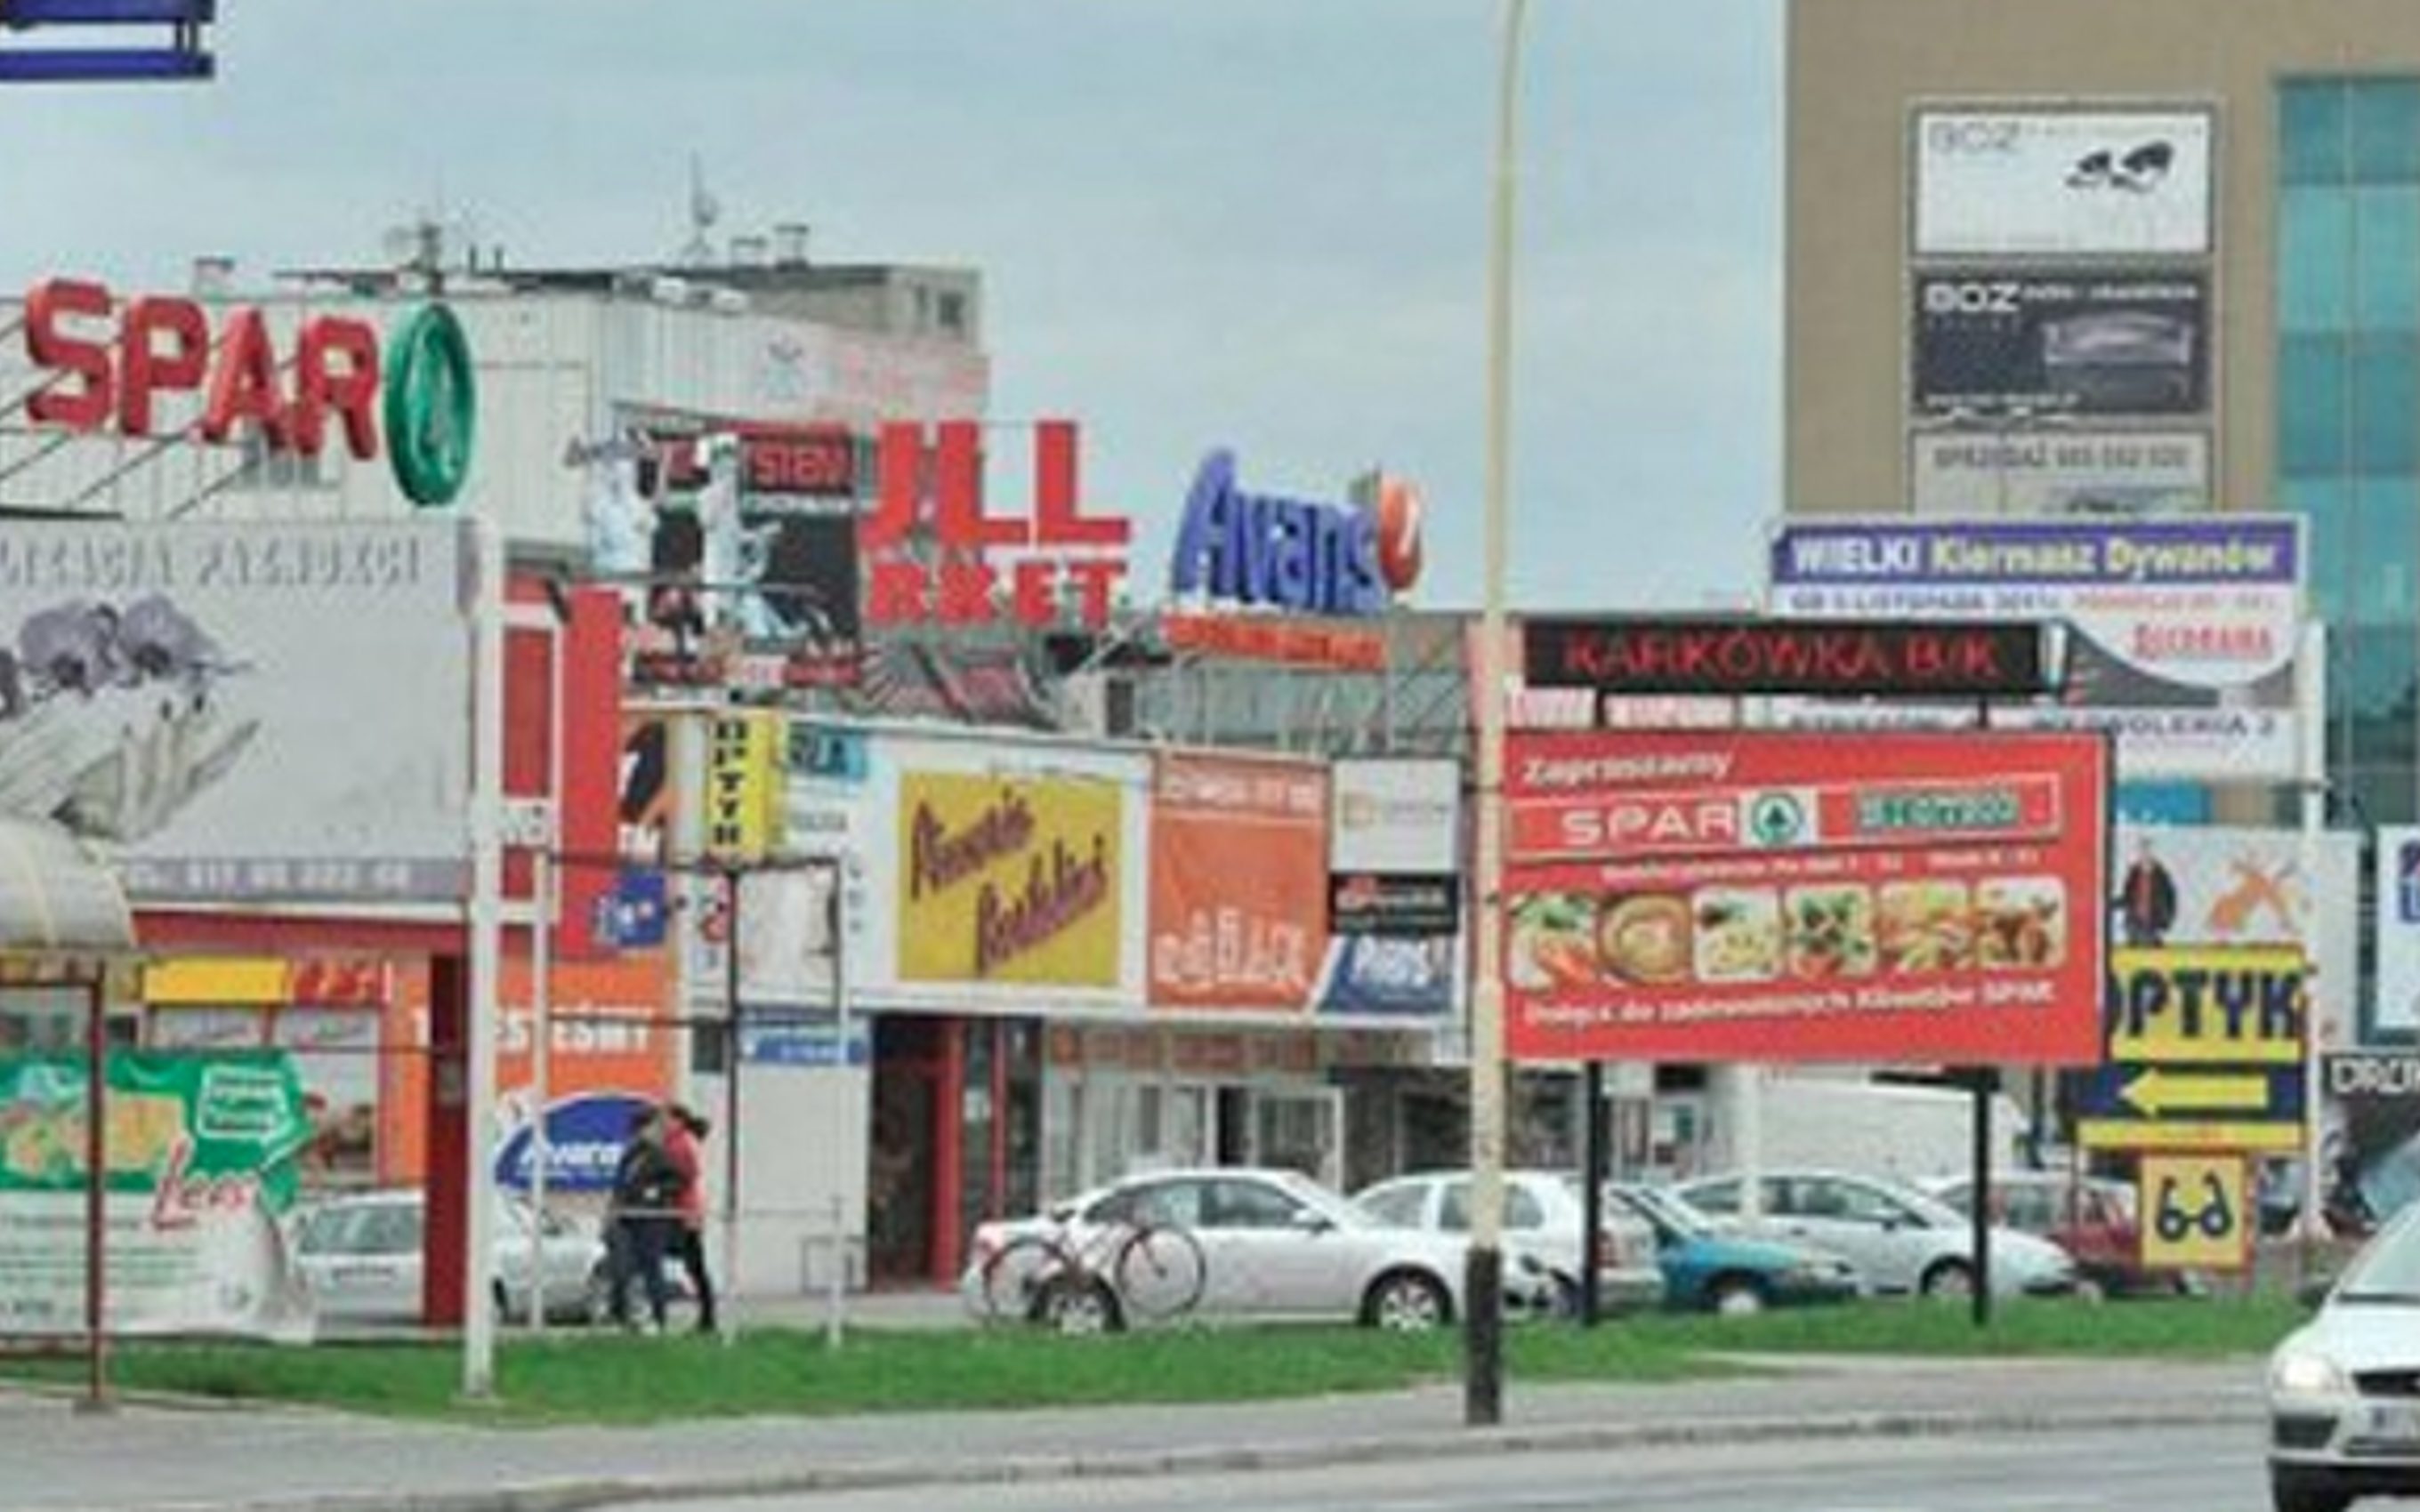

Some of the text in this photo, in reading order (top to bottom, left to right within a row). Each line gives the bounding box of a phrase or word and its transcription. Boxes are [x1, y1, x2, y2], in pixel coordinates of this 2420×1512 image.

[24, 277, 379, 461] SPAR
[1170, 447, 1383, 616] Avans
[1795, 536, 1919, 574] WIELKI
[1566, 623, 1890, 681] KARKÓWKA
[1562, 802, 1735, 846] SPAR
